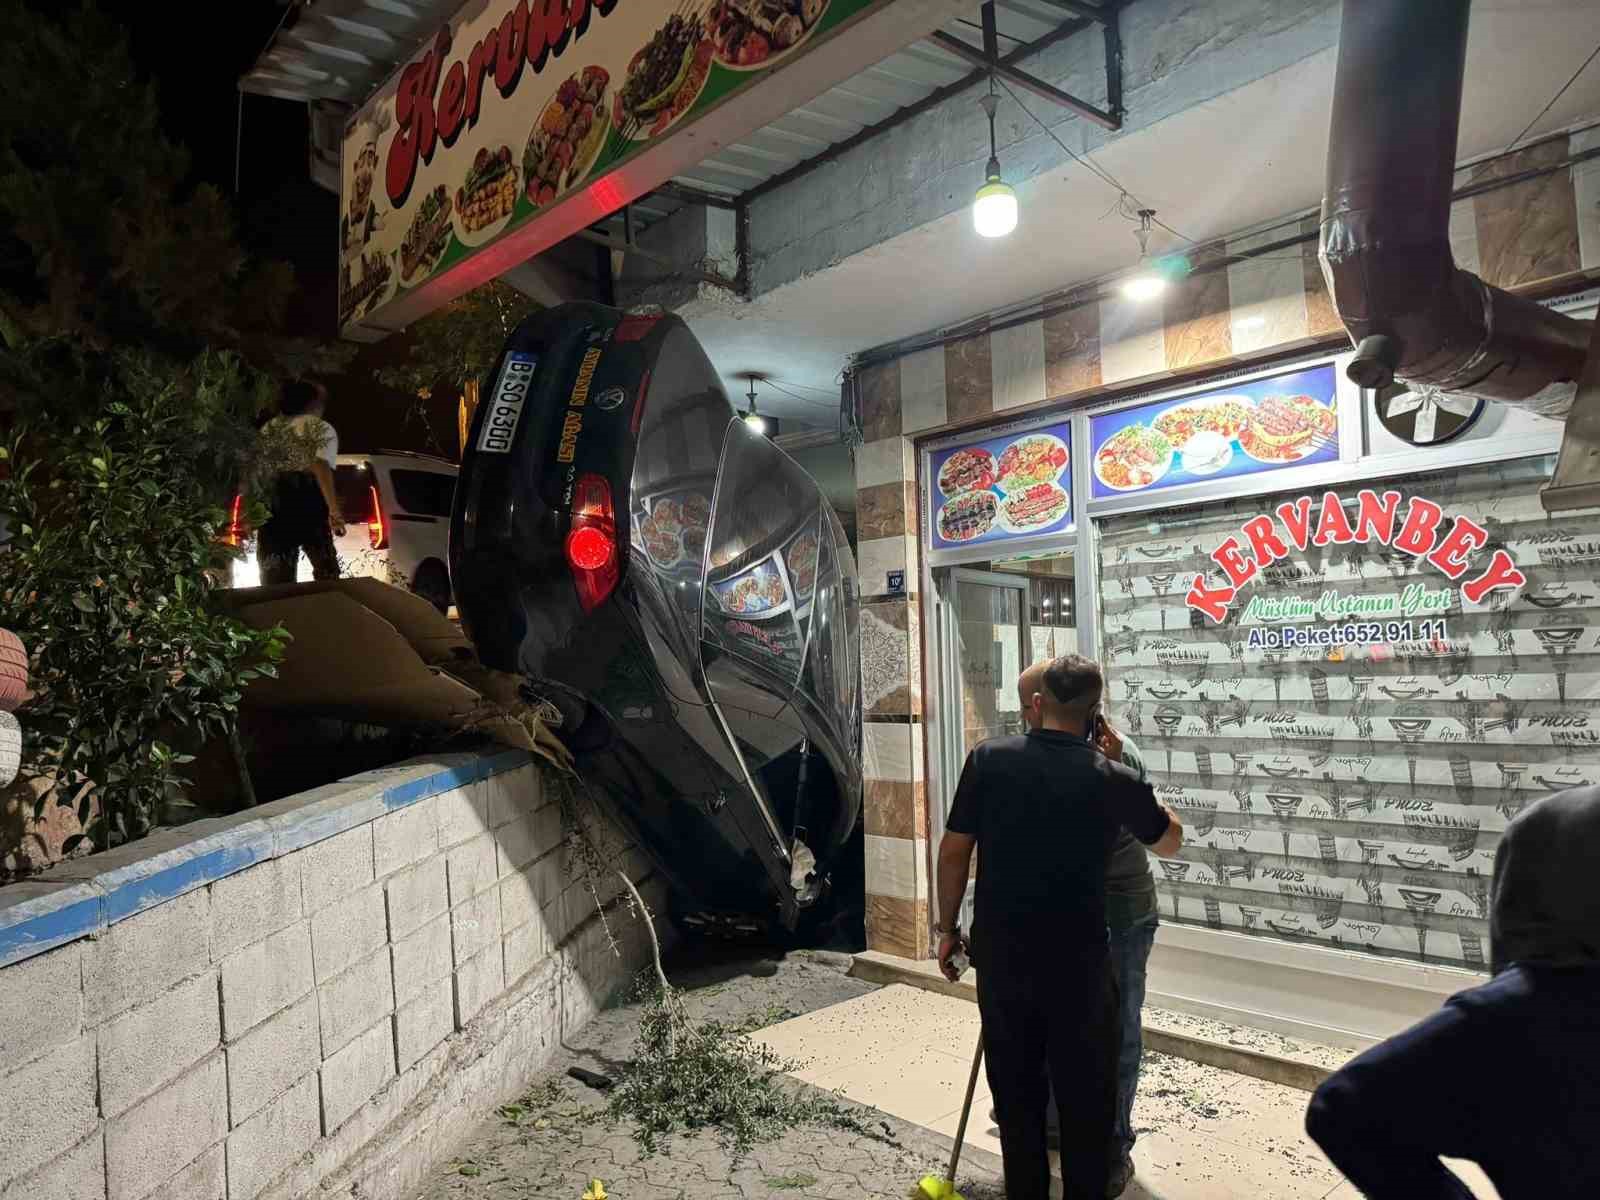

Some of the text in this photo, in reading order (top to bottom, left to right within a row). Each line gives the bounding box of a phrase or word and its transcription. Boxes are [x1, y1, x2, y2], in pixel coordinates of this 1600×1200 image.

[486, 361, 530, 451] B SO 6300
[1185, 491, 1527, 624] KERVANBEY
[1240, 583, 1453, 623] Müslüm Ustanın Yeri
[1249, 627, 1279, 649] Alo
[1387, 620, 1413, 642] 91
[1421, 619, 1447, 641] 11
